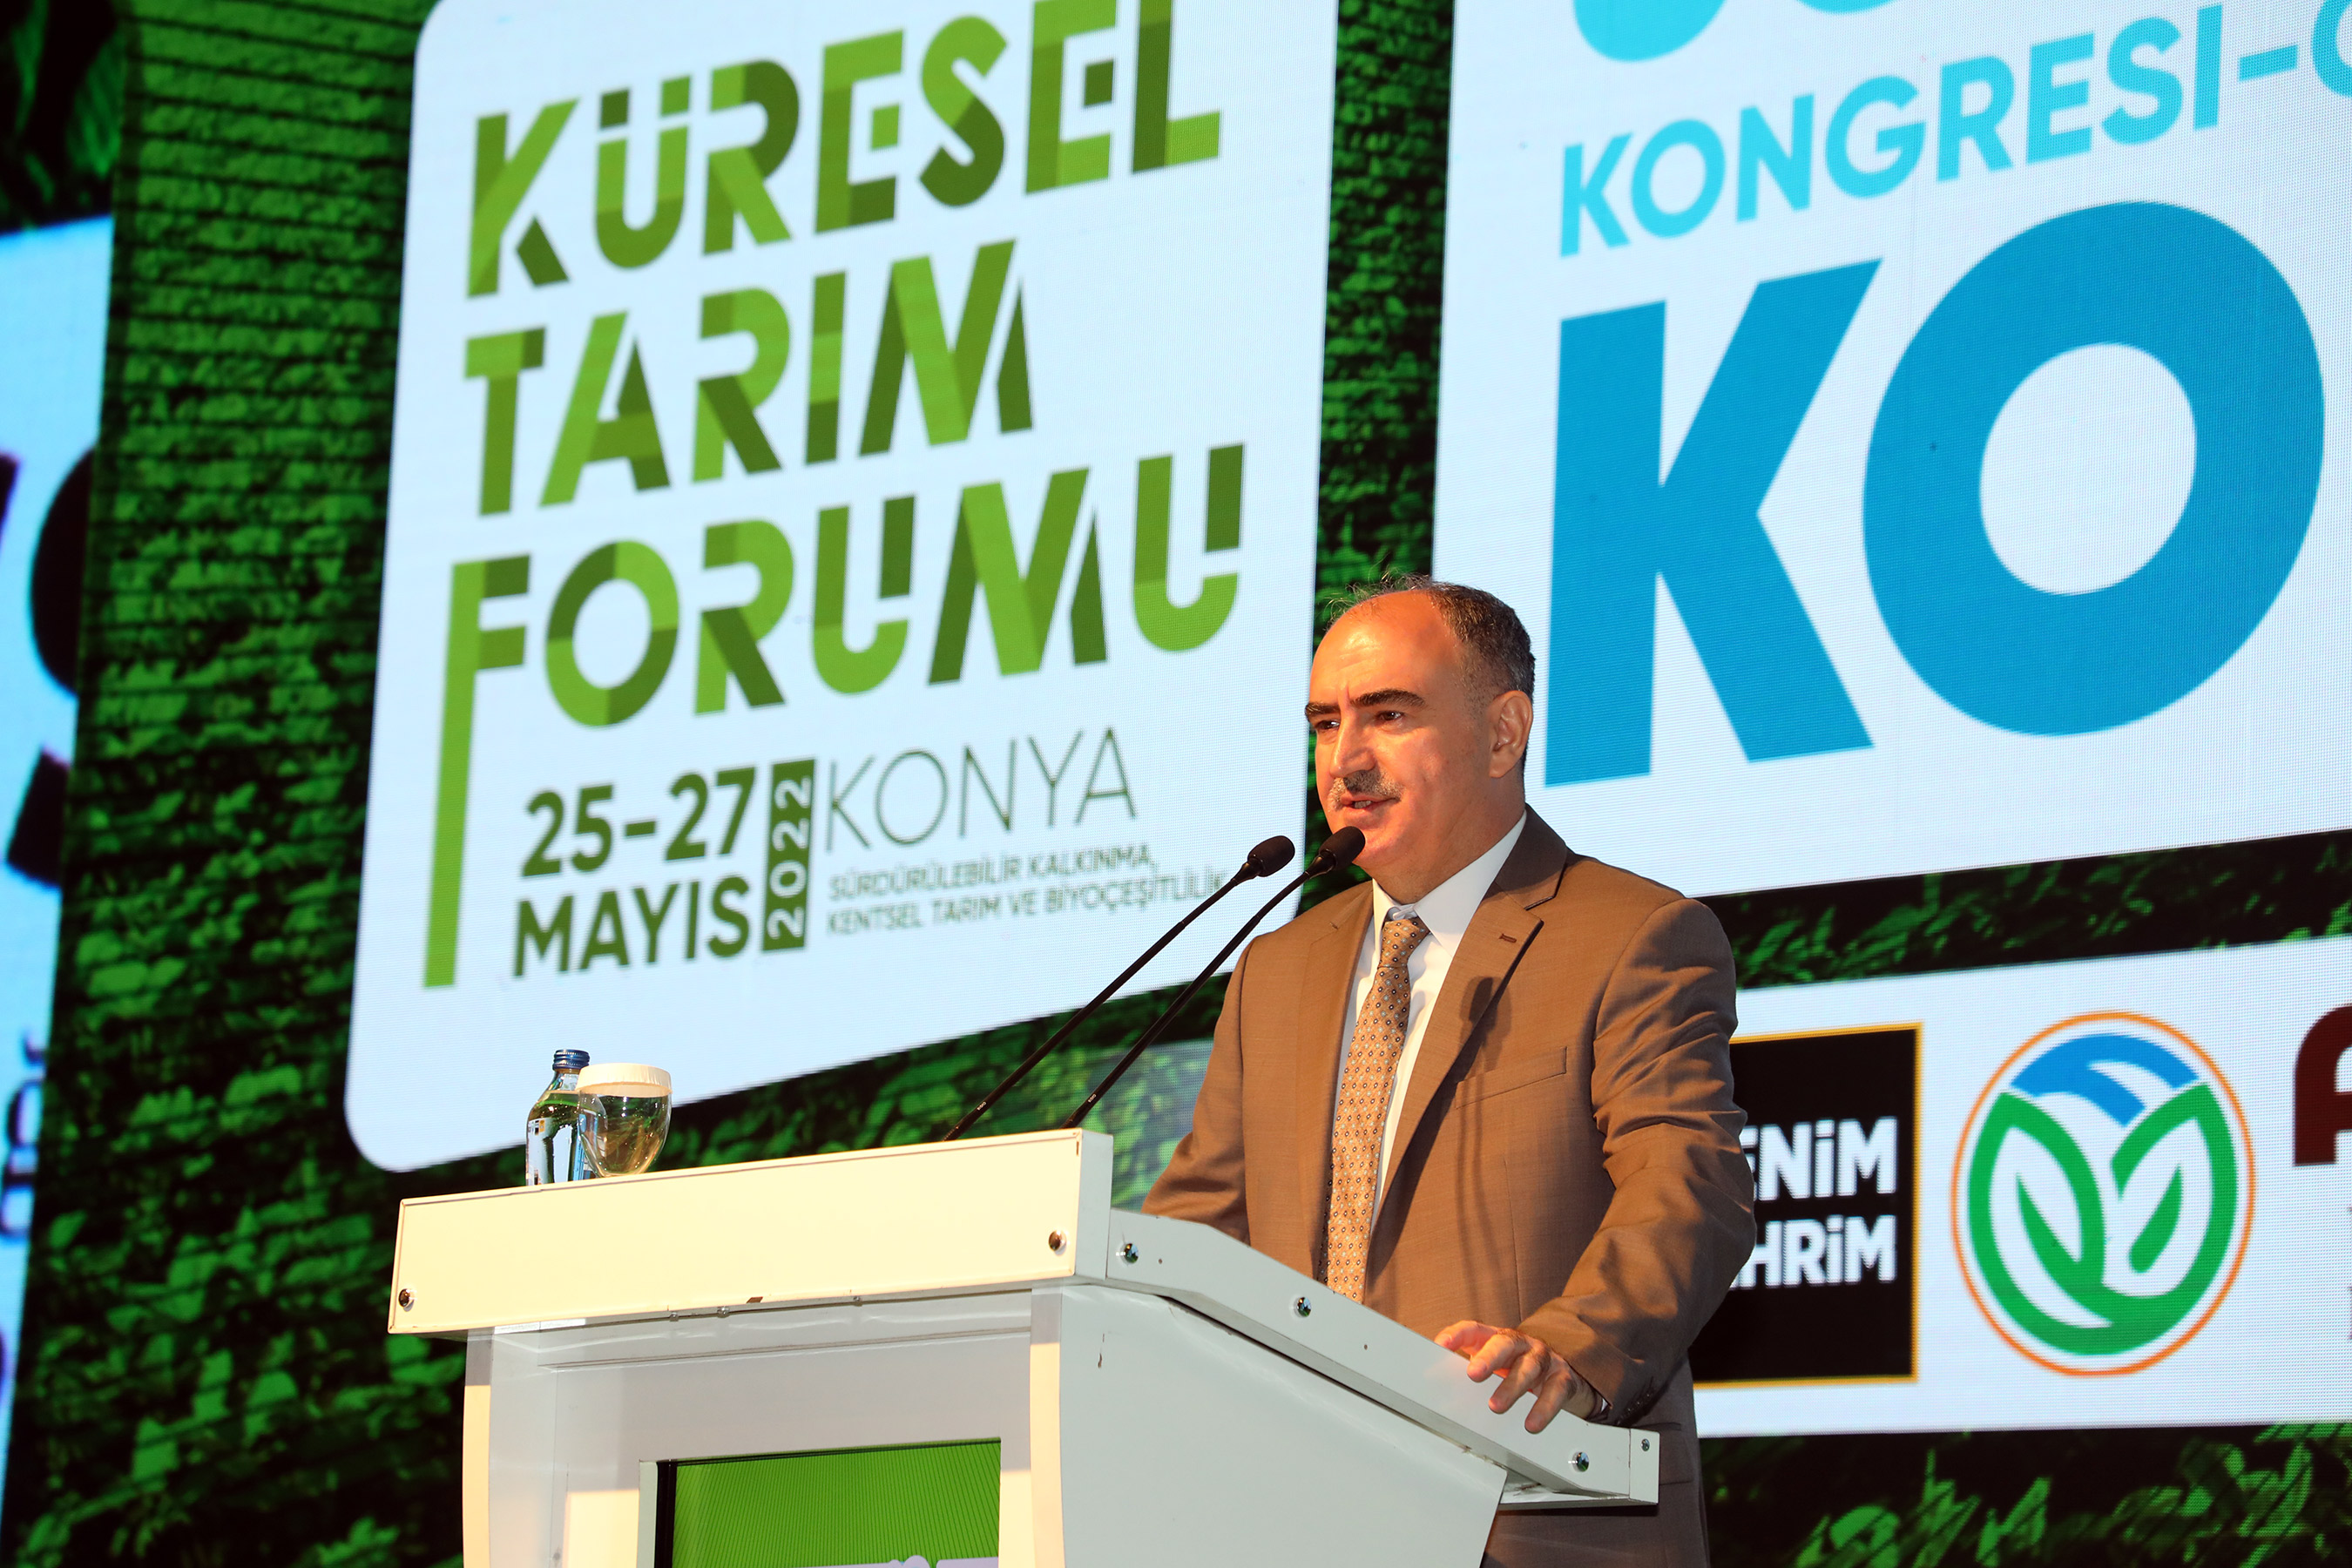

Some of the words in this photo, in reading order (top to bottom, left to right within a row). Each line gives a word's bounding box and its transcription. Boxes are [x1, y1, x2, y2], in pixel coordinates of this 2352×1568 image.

[467, 0, 1221, 299] KÜRESEL
[464, 239, 1033, 517] TARIM
[1544, 200, 2325, 787] KO
[424, 443, 1245, 988] FORUMU
[825, 727, 1136, 854] KONYA
[521, 766, 756, 878] 25-27
[767, 775, 812, 940] 2022
[513, 875, 751, 978] MAYIS
[827, 902, 923, 935] KENTSEL
[931, 895, 1002, 923] TARIM
[1007, 888, 1037, 916] VE
